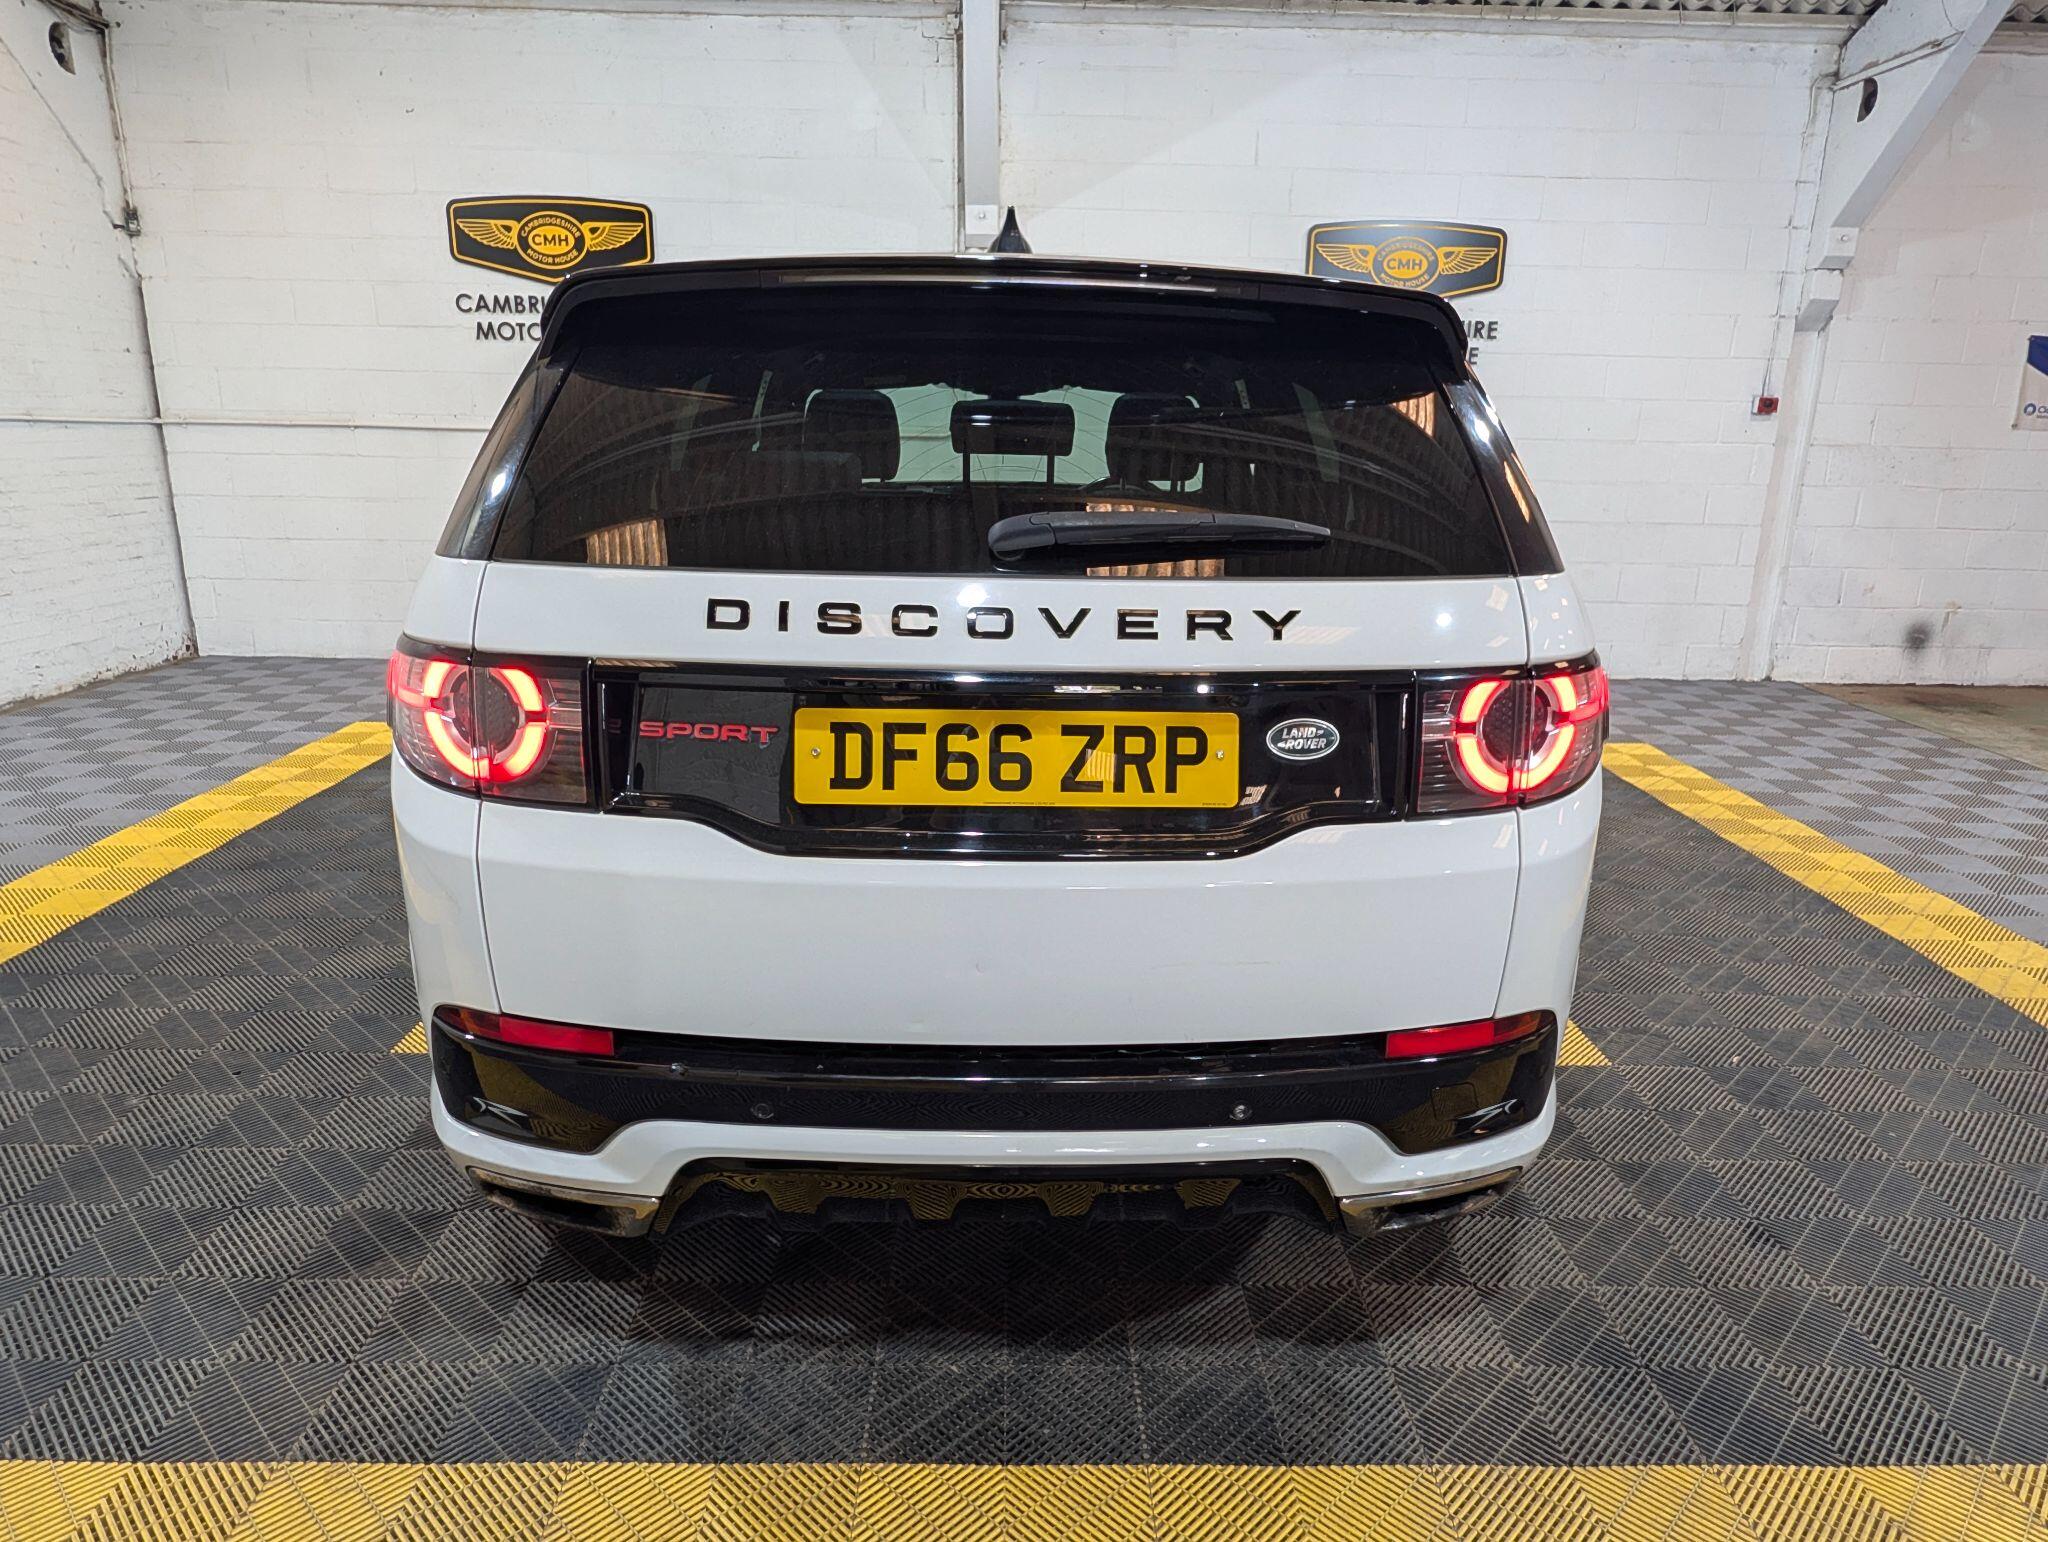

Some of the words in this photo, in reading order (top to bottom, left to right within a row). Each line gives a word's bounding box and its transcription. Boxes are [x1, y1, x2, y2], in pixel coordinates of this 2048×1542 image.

[521, 217, 581, 238] CAMBRIDGESHIRE
[532, 233, 569, 247] CMH
[526, 248, 553, 264] MOTOR
[554, 249, 579, 264] HOUSE
[1387, 258, 1423, 271] CMH
[1461, 320, 1498, 339] IRE
[706, 598, 1302, 642] DISCOVERY
[639, 721, 778, 744] SPORT
[1281, 728, 1316, 738] LAND
[1285, 738, 1326, 749] ROVER
[829, 721, 1034, 792] DF66
[1060, 725, 1209, 794] ZRP
